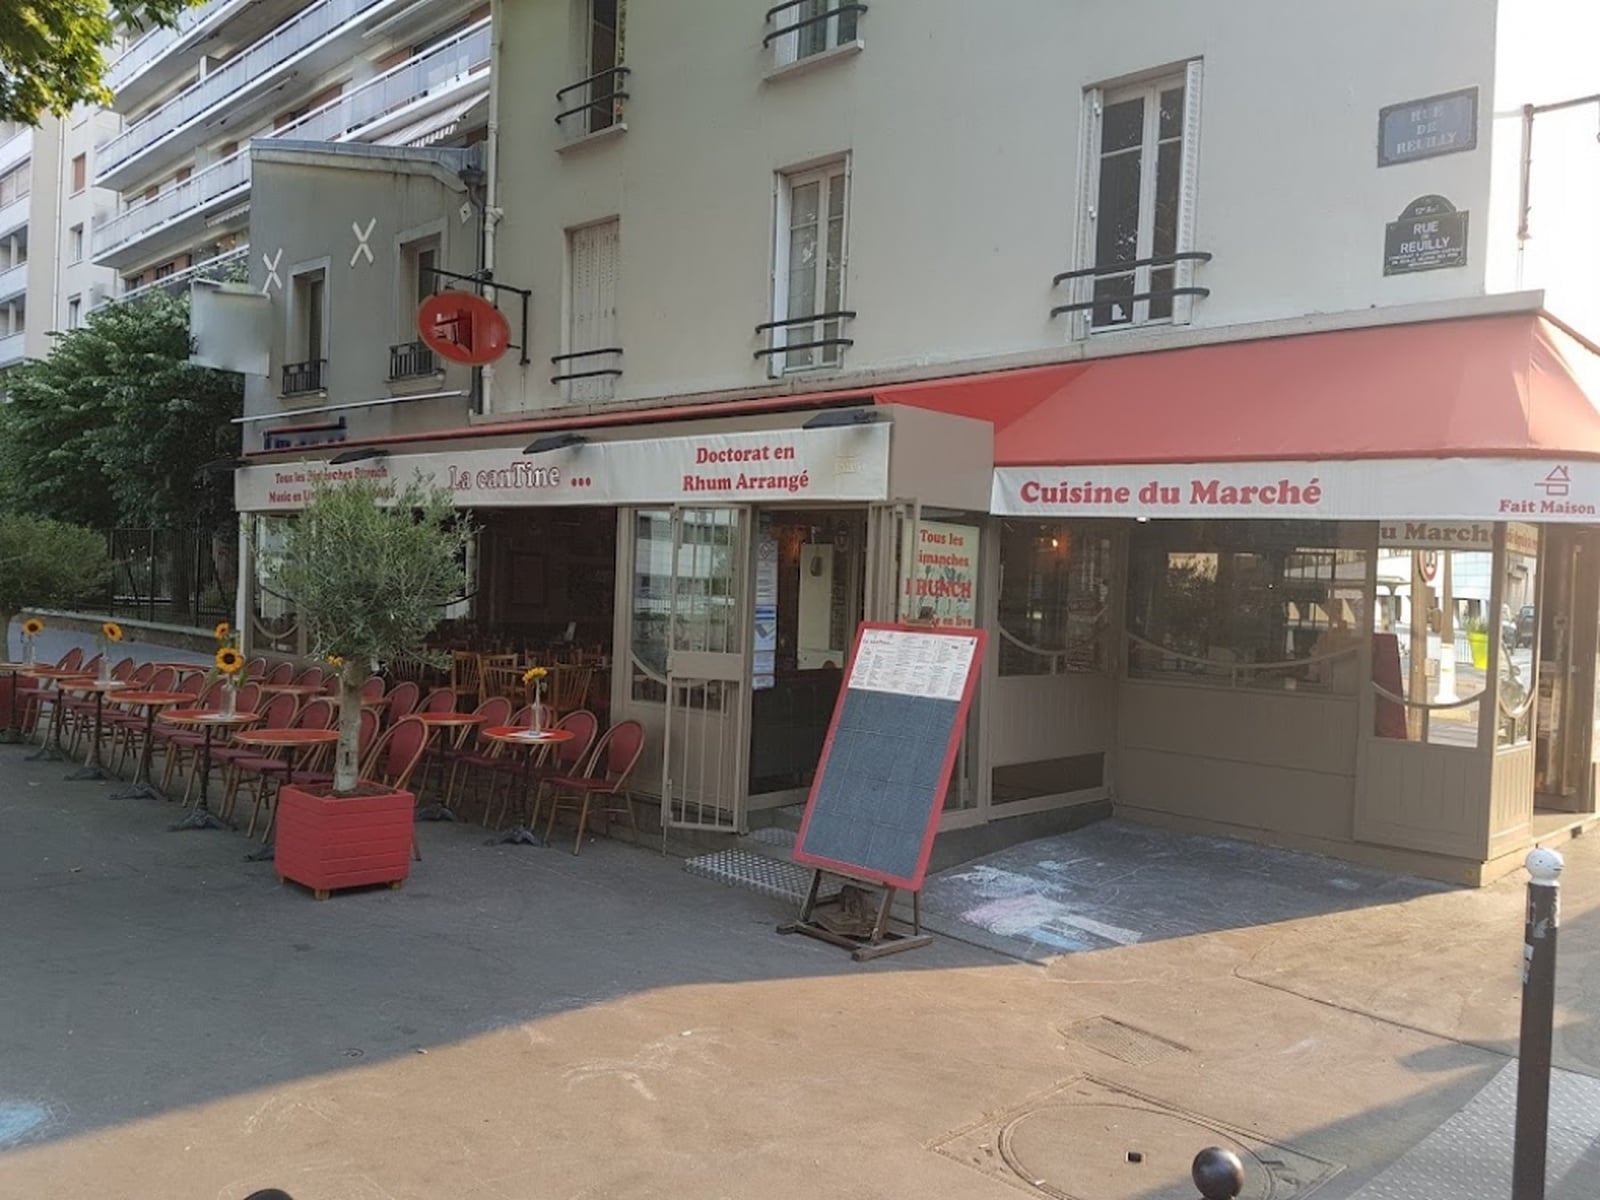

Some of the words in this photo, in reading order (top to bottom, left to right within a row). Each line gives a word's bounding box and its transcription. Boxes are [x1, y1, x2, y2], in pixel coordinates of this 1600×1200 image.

[1416, 121, 1437, 136] DE
[1413, 219, 1440, 235] RUE
[1400, 236, 1450, 254] REUILLY
[696, 445, 770, 464] Doctorat
[774, 446, 795, 461] en
[275, 472, 293, 485] Tous
[449, 465, 471, 490] La
[683, 474, 732, 492] Rhum
[736, 470, 809, 493] Arrangé
[1020, 480, 1130, 504] Cuisine
[1138, 481, 1182, 505] du
[1190, 478, 1322, 506] Marché
[1499, 499, 1536, 513] Fait
[1540, 500, 1596, 515] Maison
[920, 528, 946, 545] Tous
[948, 532, 964, 546] les
[1380, 526, 1397, 540] u
[918, 549, 969, 568] imanches
